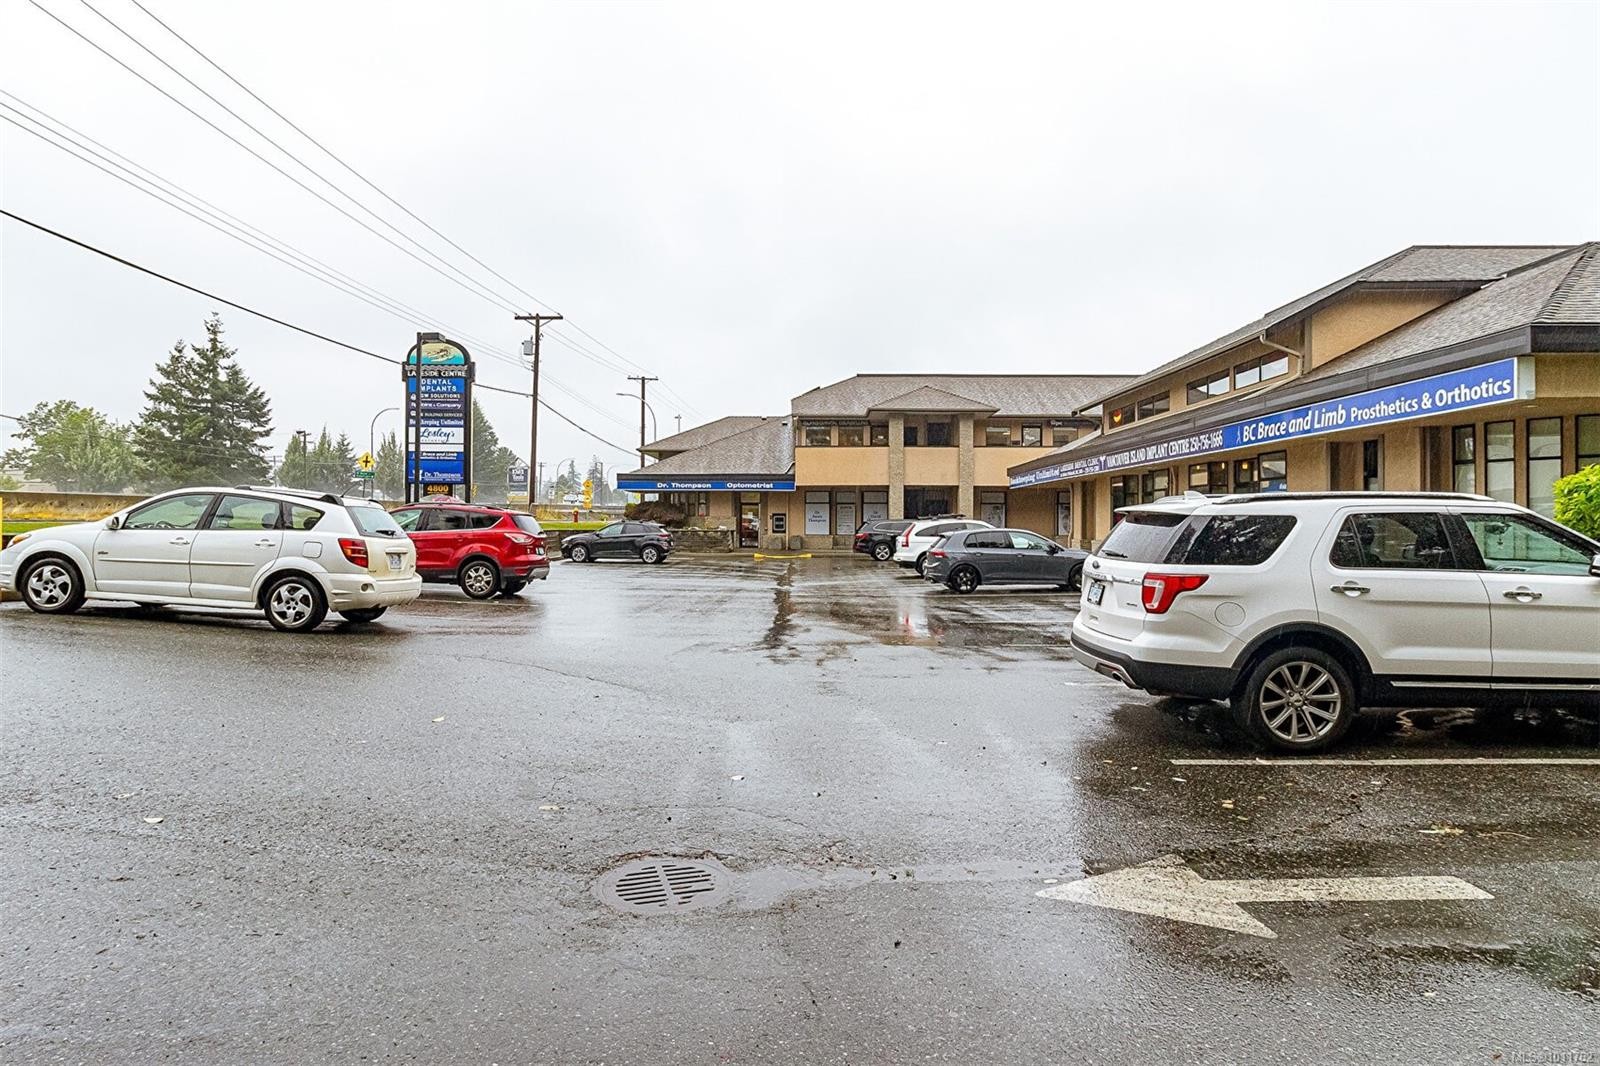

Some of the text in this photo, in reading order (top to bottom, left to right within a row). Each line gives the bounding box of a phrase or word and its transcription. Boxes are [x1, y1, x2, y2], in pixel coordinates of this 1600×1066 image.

[1243, 377, 1512, 442] BC Brace and Limb Prosthetics & Orthotics
[1106, 453, 1130, 467] VANCOUVER
[1130, 449, 1146, 463] ISLAND
[1146, 444, 1168, 460] IMPLANT
[1168, 439, 1190, 456] CENTRE
[1087, 458, 1099, 468] CLINIC
[1036, 467, 1060, 480] Unlimited
[671, 482, 712, 490] Thompson
[726, 482, 774, 490] Optometrist
